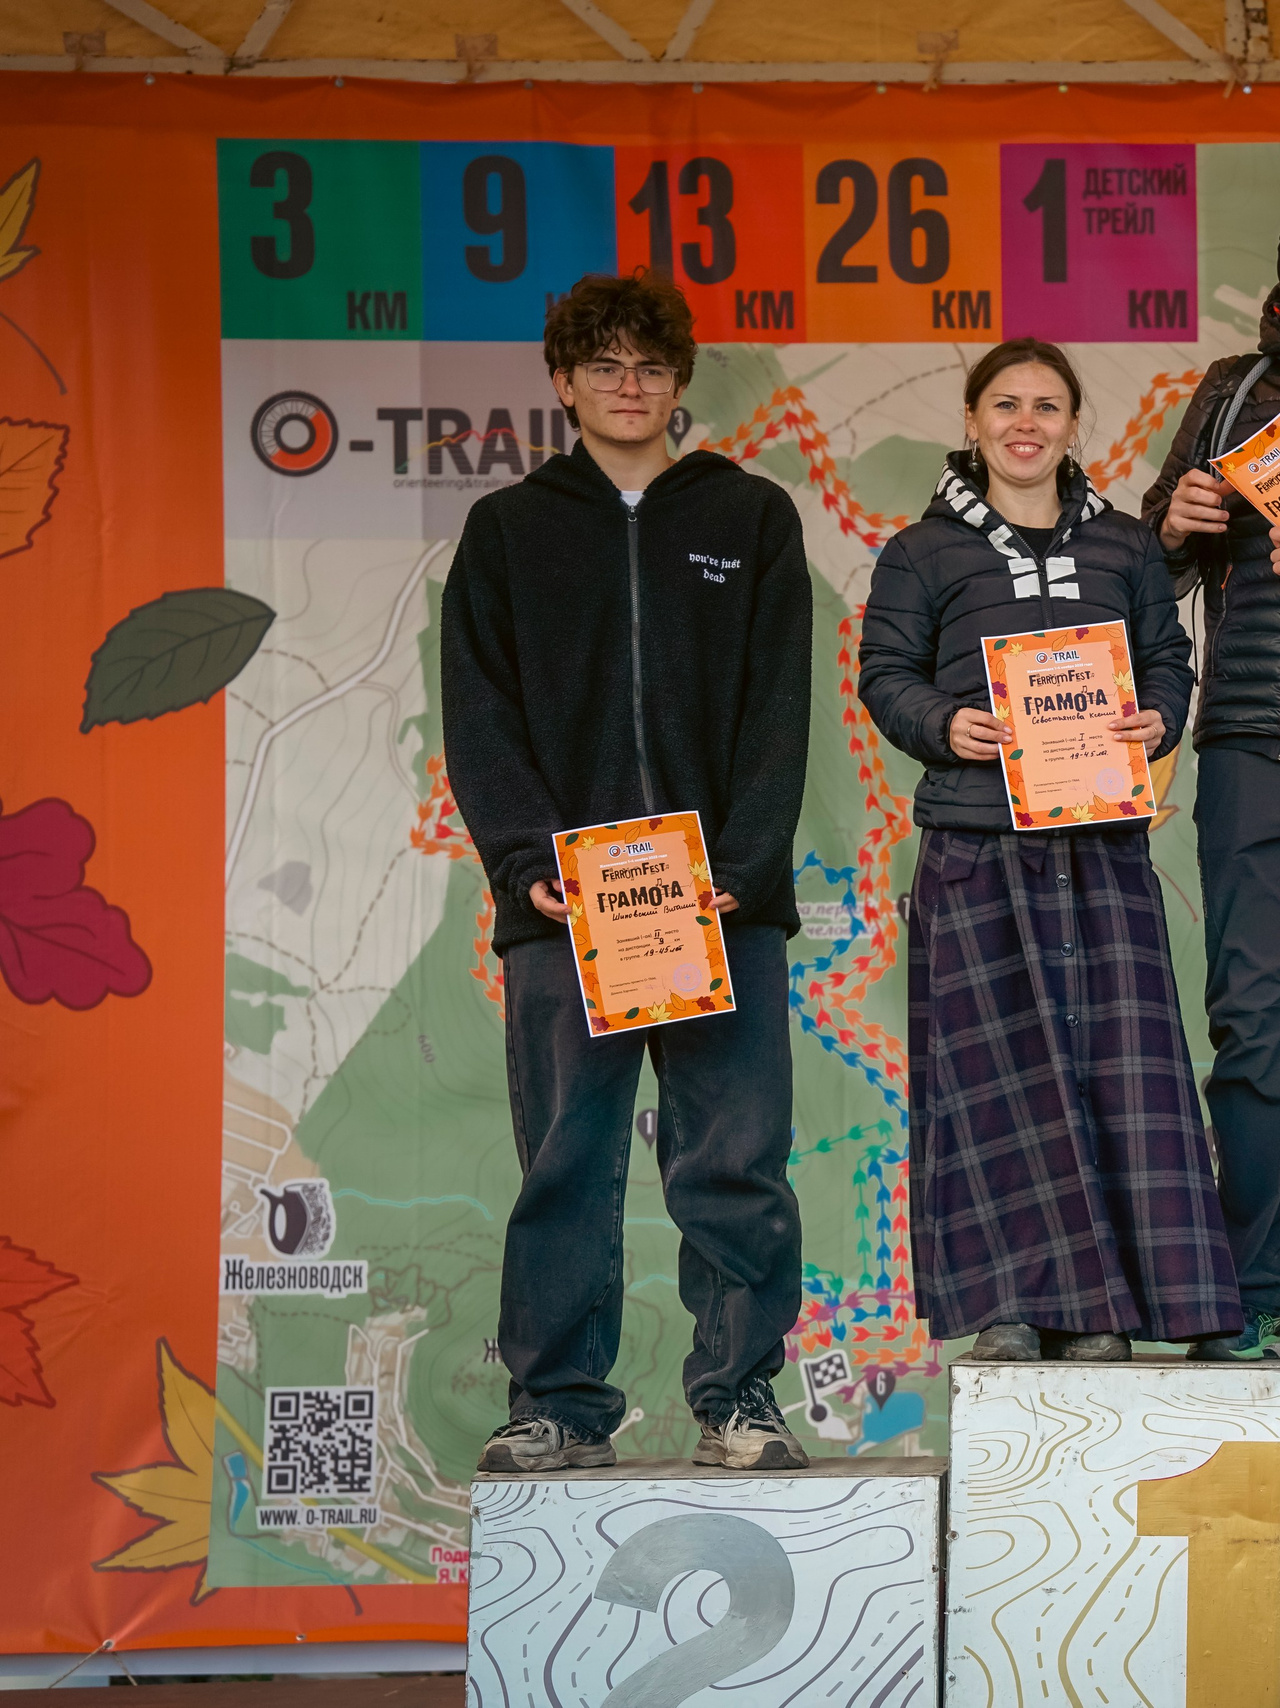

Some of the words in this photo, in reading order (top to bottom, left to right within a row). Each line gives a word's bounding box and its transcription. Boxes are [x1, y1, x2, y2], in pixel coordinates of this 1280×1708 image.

[1082, 163, 1187, 199] ДЕТСКИЙ
[249, 151, 315, 280] 3
[462, 155, 528, 283] 9
[628, 157, 736, 285] 13
[815, 157, 950, 284] 26
[1022, 159, 1068, 283] 1
[1083, 203, 1155, 235] ТРЕЙЛ
[347, 291, 407, 330] КМ
[735, 290, 794, 329] КМ
[932, 290, 991, 329] КМ
[1127, 290, 1187, 329] КМ
[674, 410, 684, 433] 3
[704, 569, 725, 583] dead
[1036, 651, 1079, 663] O-TRAIL
[1024, 689, 1108, 715] ГРАМОТА
[609, 842, 653, 857] O-TRAIL
[597, 881, 684, 913] ГРАМОТА
[646, 1111, 653, 1135] 1
[225, 1259, 363, 1293] Железноводск
[875, 1380, 885, 1396] 6
[306, 1508, 377, 1525] O-TRAIL.RU
[594, 1513, 796, 1708] 2
